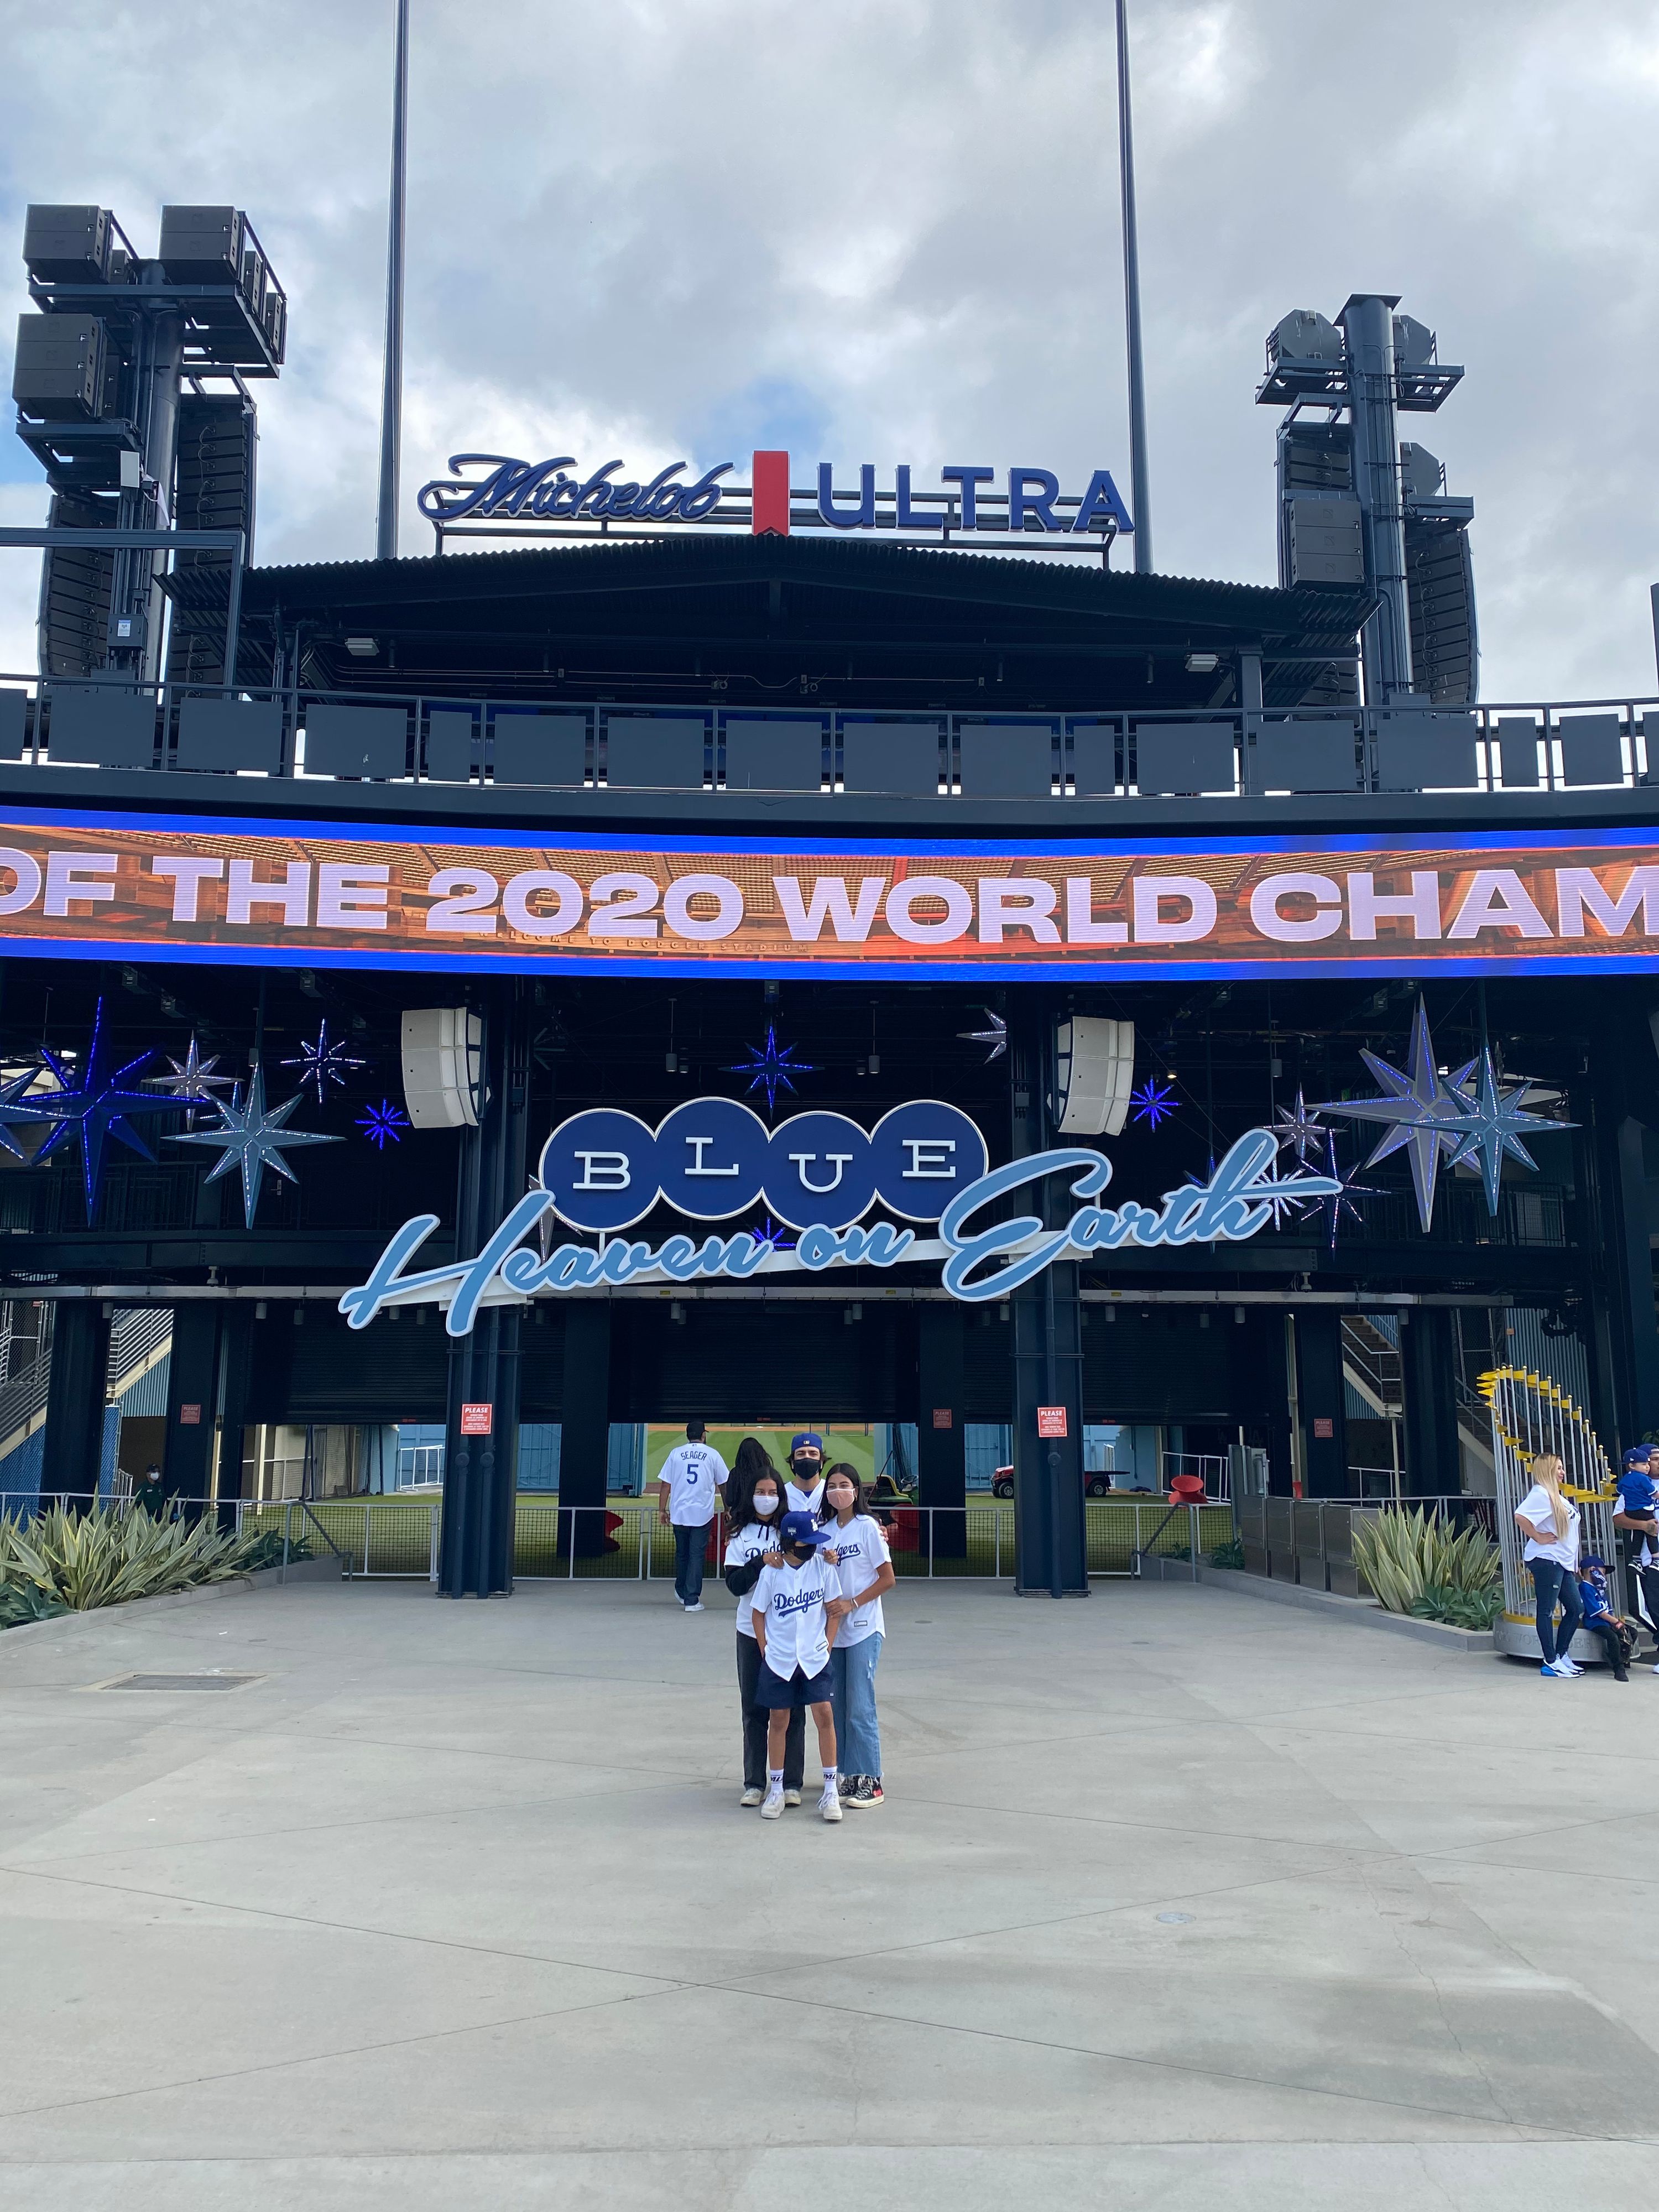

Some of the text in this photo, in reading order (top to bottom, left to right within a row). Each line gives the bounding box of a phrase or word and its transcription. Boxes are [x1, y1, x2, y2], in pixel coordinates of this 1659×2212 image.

[418, 453, 1135, 535] Michelob ULTRA
[152, 855, 389, 930] THE
[426, 867, 745, 940] 2020
[773, 875, 1218, 945] WORLD
[1249, 865, 1659, 942] CHAM
[627, 939, 706, 951] DODGER
[721, 943, 808, 953] STADIUM
[572, 1136, 958, 1192] BLUE
[338, 1128, 1343, 1337] Heaven on Earth
[680, 1451, 707, 1462] SEAGER
[686, 1463, 699, 1485] 5
[774, 1588, 824, 1614] Dodgers
